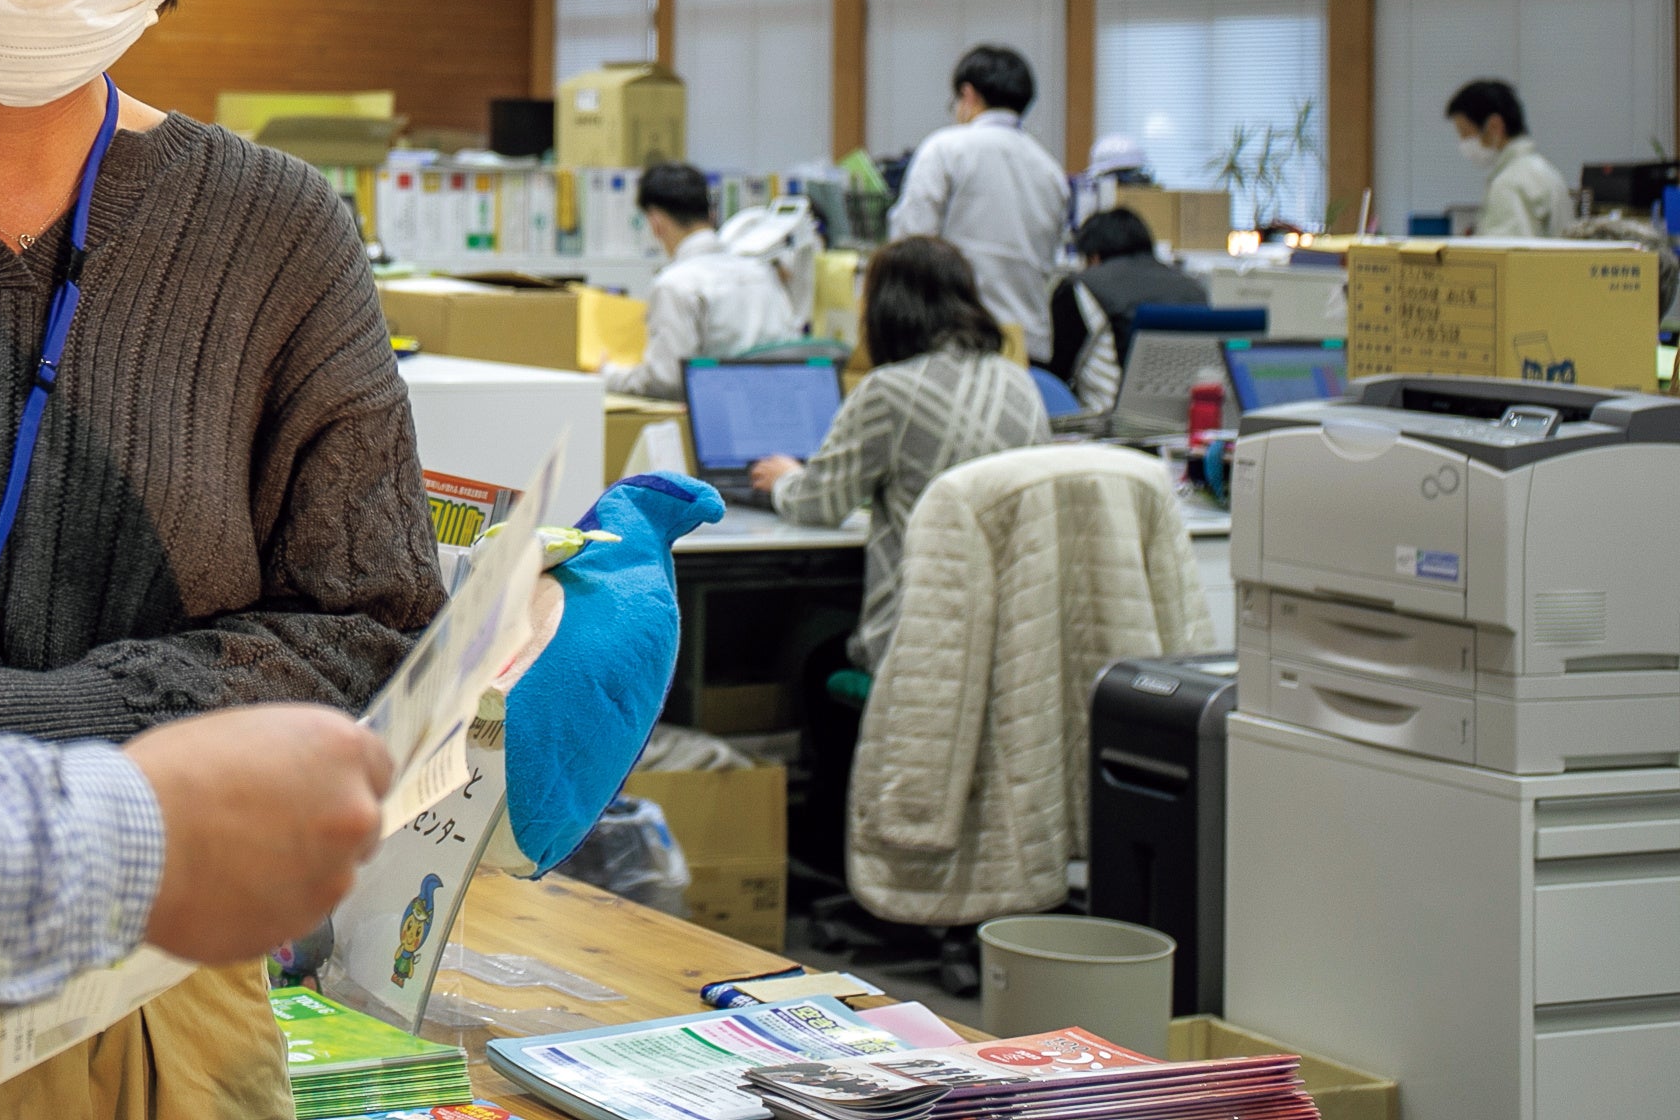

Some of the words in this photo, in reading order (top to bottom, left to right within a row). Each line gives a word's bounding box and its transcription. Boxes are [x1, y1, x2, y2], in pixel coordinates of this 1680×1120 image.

[428, 497, 485, 547] 川町
[463, 766, 483, 799] と
[404, 810, 466, 844] センター
